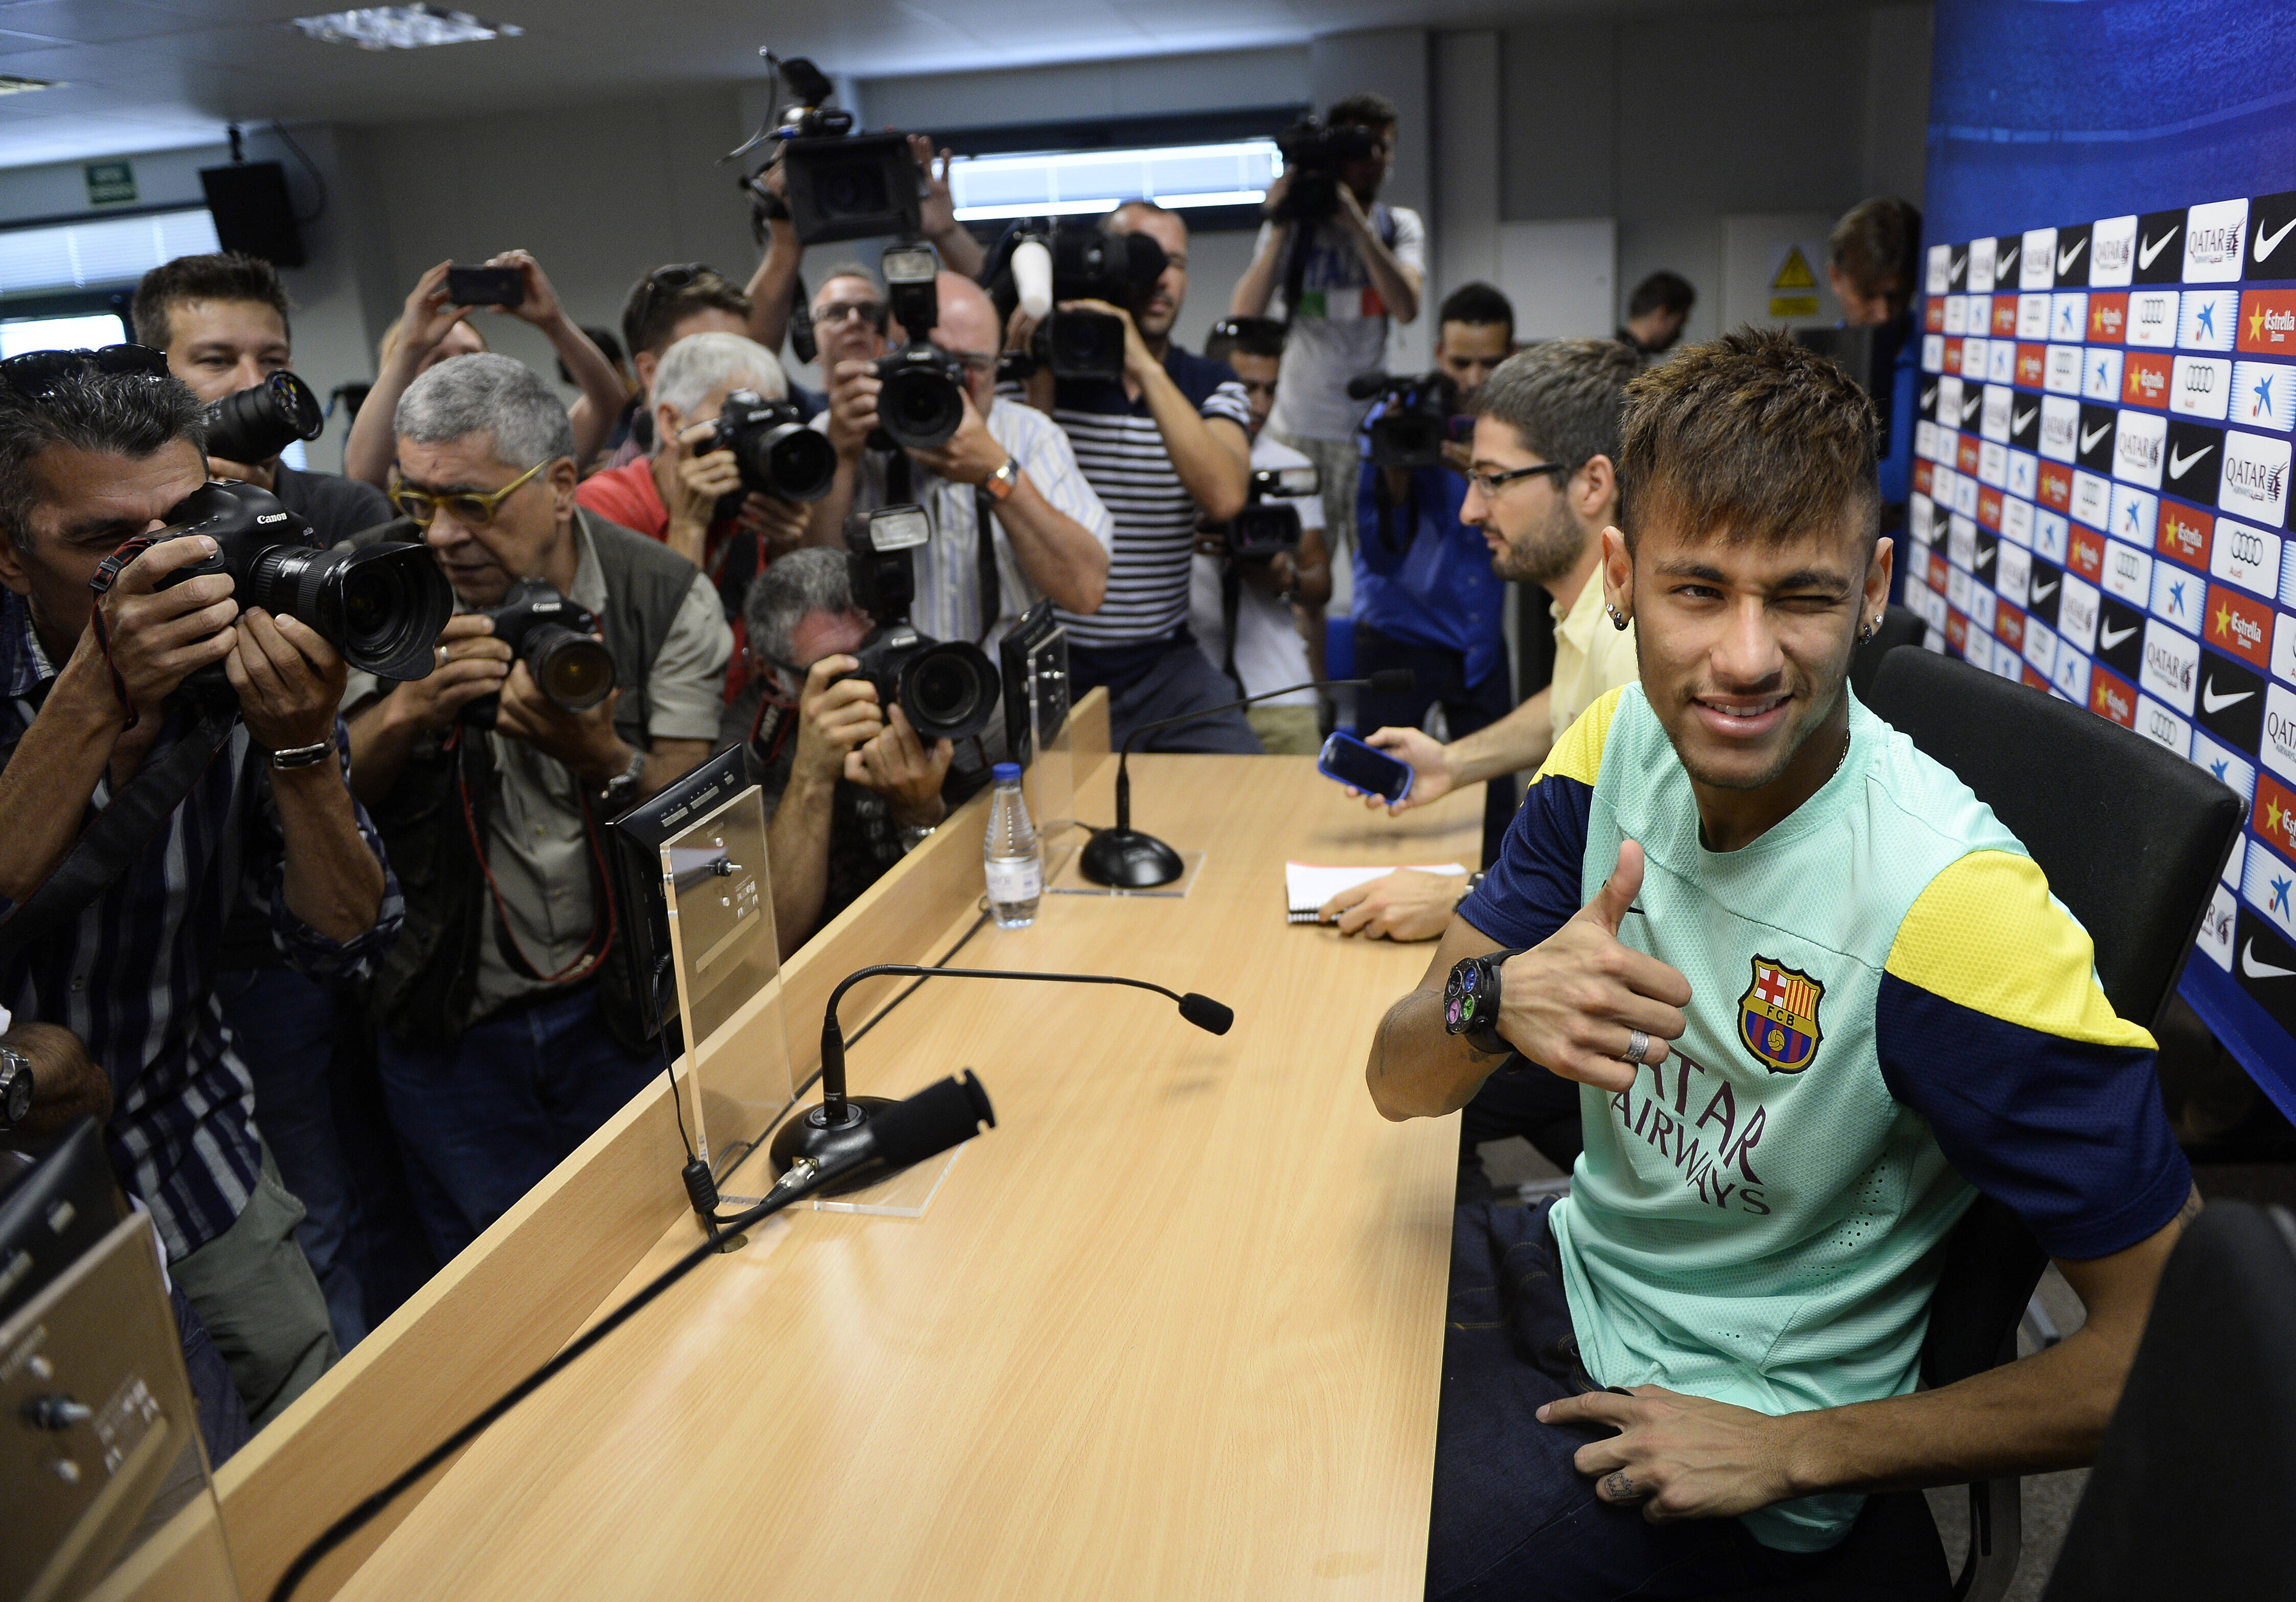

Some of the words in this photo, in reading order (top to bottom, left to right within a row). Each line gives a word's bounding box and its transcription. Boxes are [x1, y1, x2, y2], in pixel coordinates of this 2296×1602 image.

[2189, 228, 2224, 258] QATAR
[2264, 308, 2295, 331] Estrella
[2225, 457, 2265, 490] QATAR
[257, 512, 288, 524] Canon
[2231, 610, 2262, 643] Estrella
[2147, 643, 2179, 679] QATAR
[2268, 712, 2296, 749] QAT
[1767, 1004, 1795, 1026] FCB
[1647, 1045, 1764, 1185] TAR
[1610, 1089, 1770, 1216] AIRWAYS
